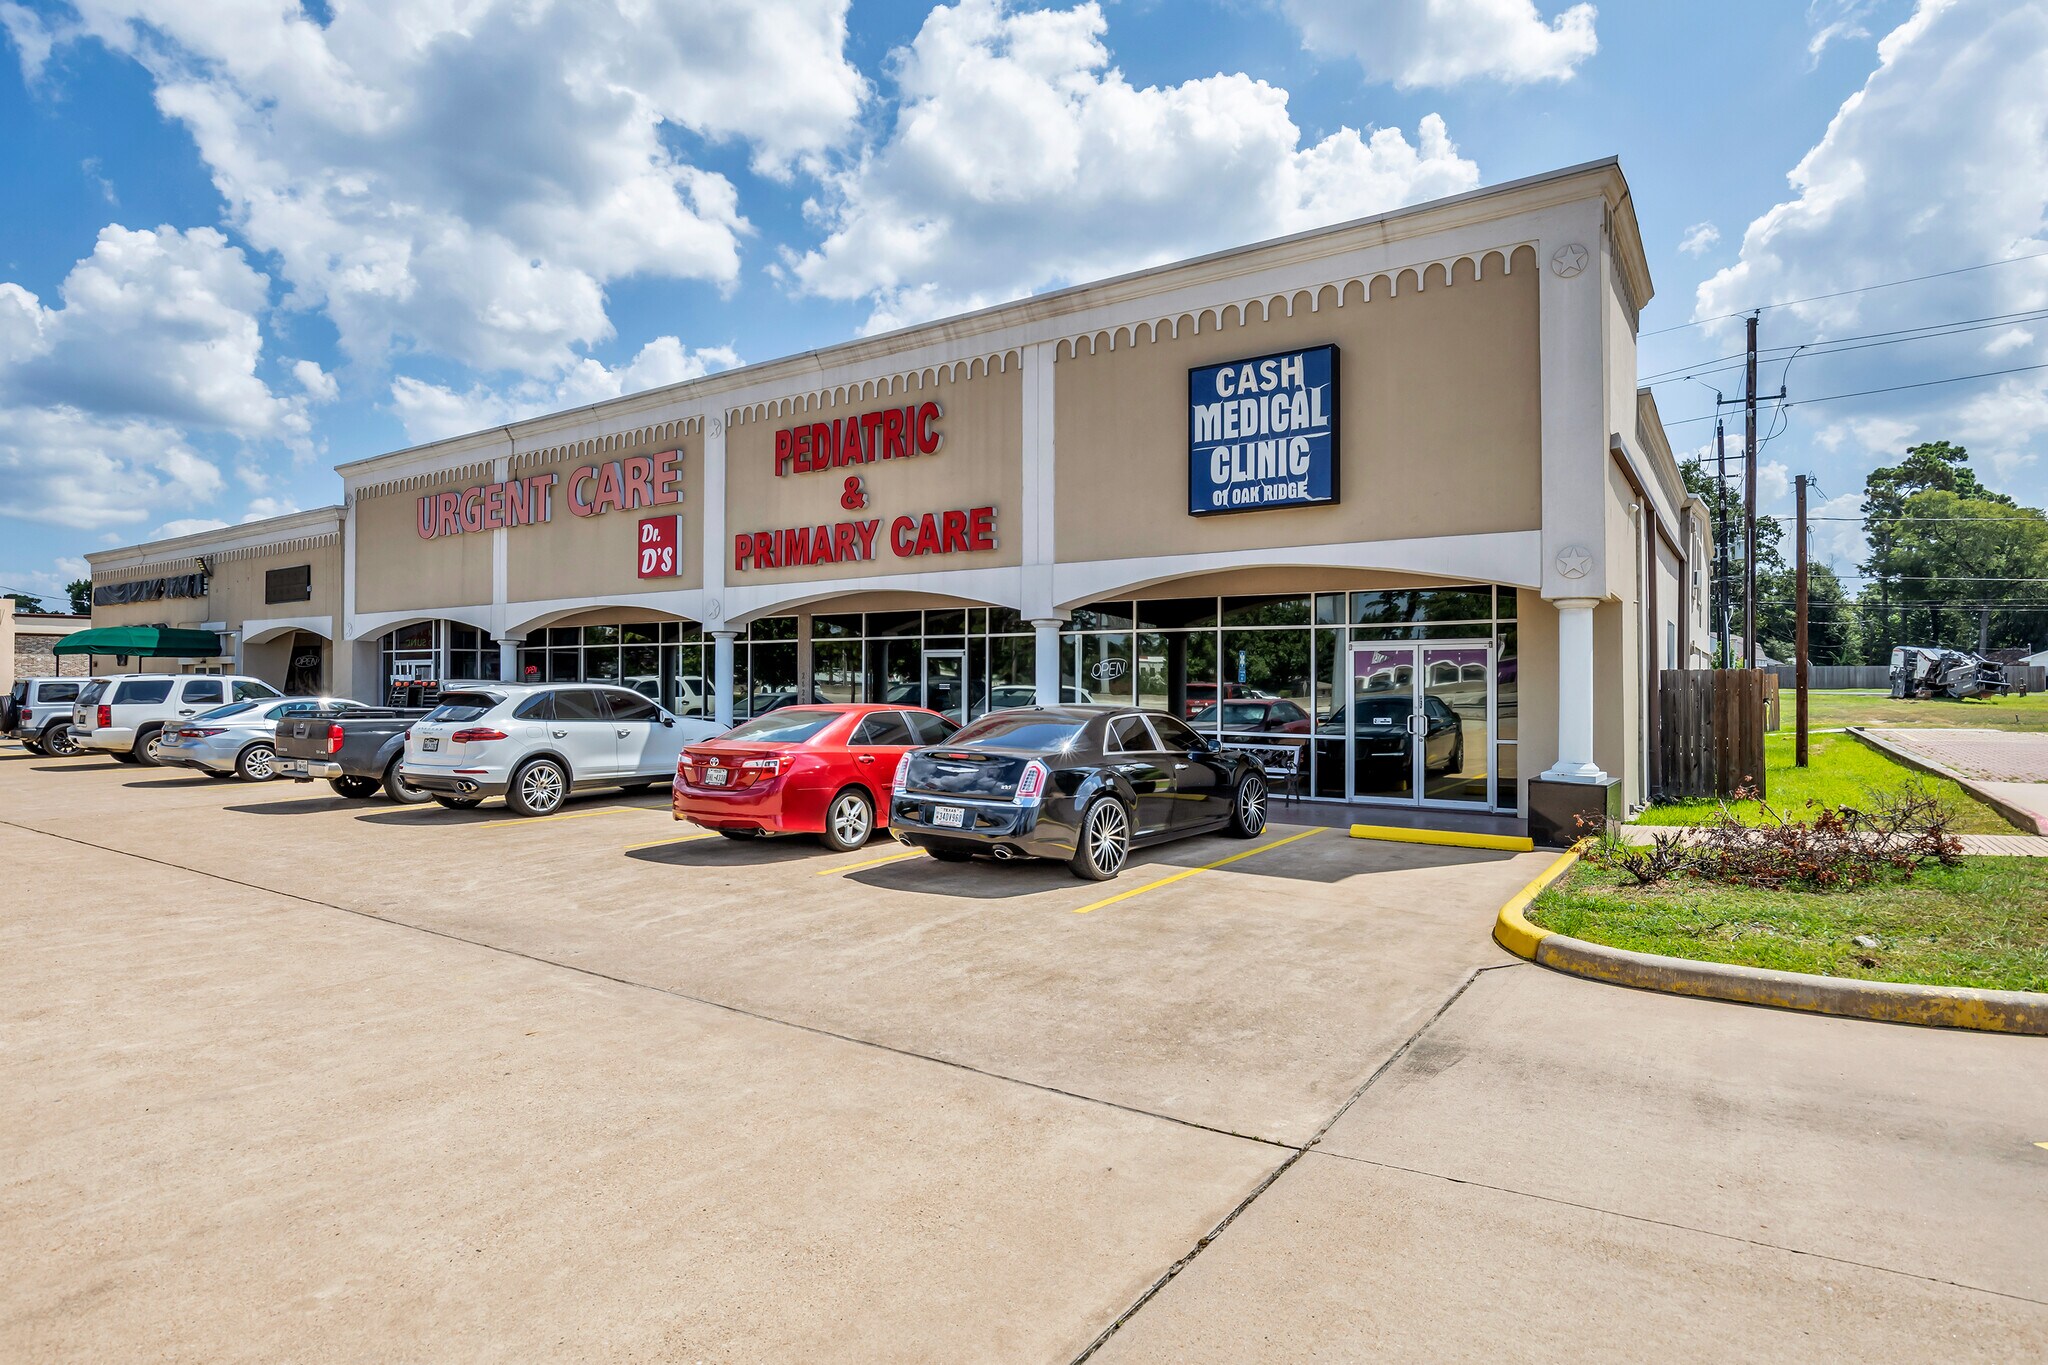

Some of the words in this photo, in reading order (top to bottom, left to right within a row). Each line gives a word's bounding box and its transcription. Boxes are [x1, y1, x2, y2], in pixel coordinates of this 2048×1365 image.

[1216, 353, 1305, 397] CASH
[1193, 385, 1329, 443] MEDICAL
[775, 401, 943, 477] PEDIATRIC
[1210, 436, 1311, 484] CLINIC
[416, 473, 557, 540] URGENT
[567, 449, 684, 517] CARE
[840, 476, 868, 510] &
[1232, 486, 1260, 504] OAK
[1264, 481, 1308, 501] RIDGE
[641, 523, 661, 543] Dr.
[735, 519, 883, 571] PRIMARY
[890, 507, 998, 558] CARE
[641, 546, 673, 574] D'S
[1092, 661, 1126, 677] OPEN
